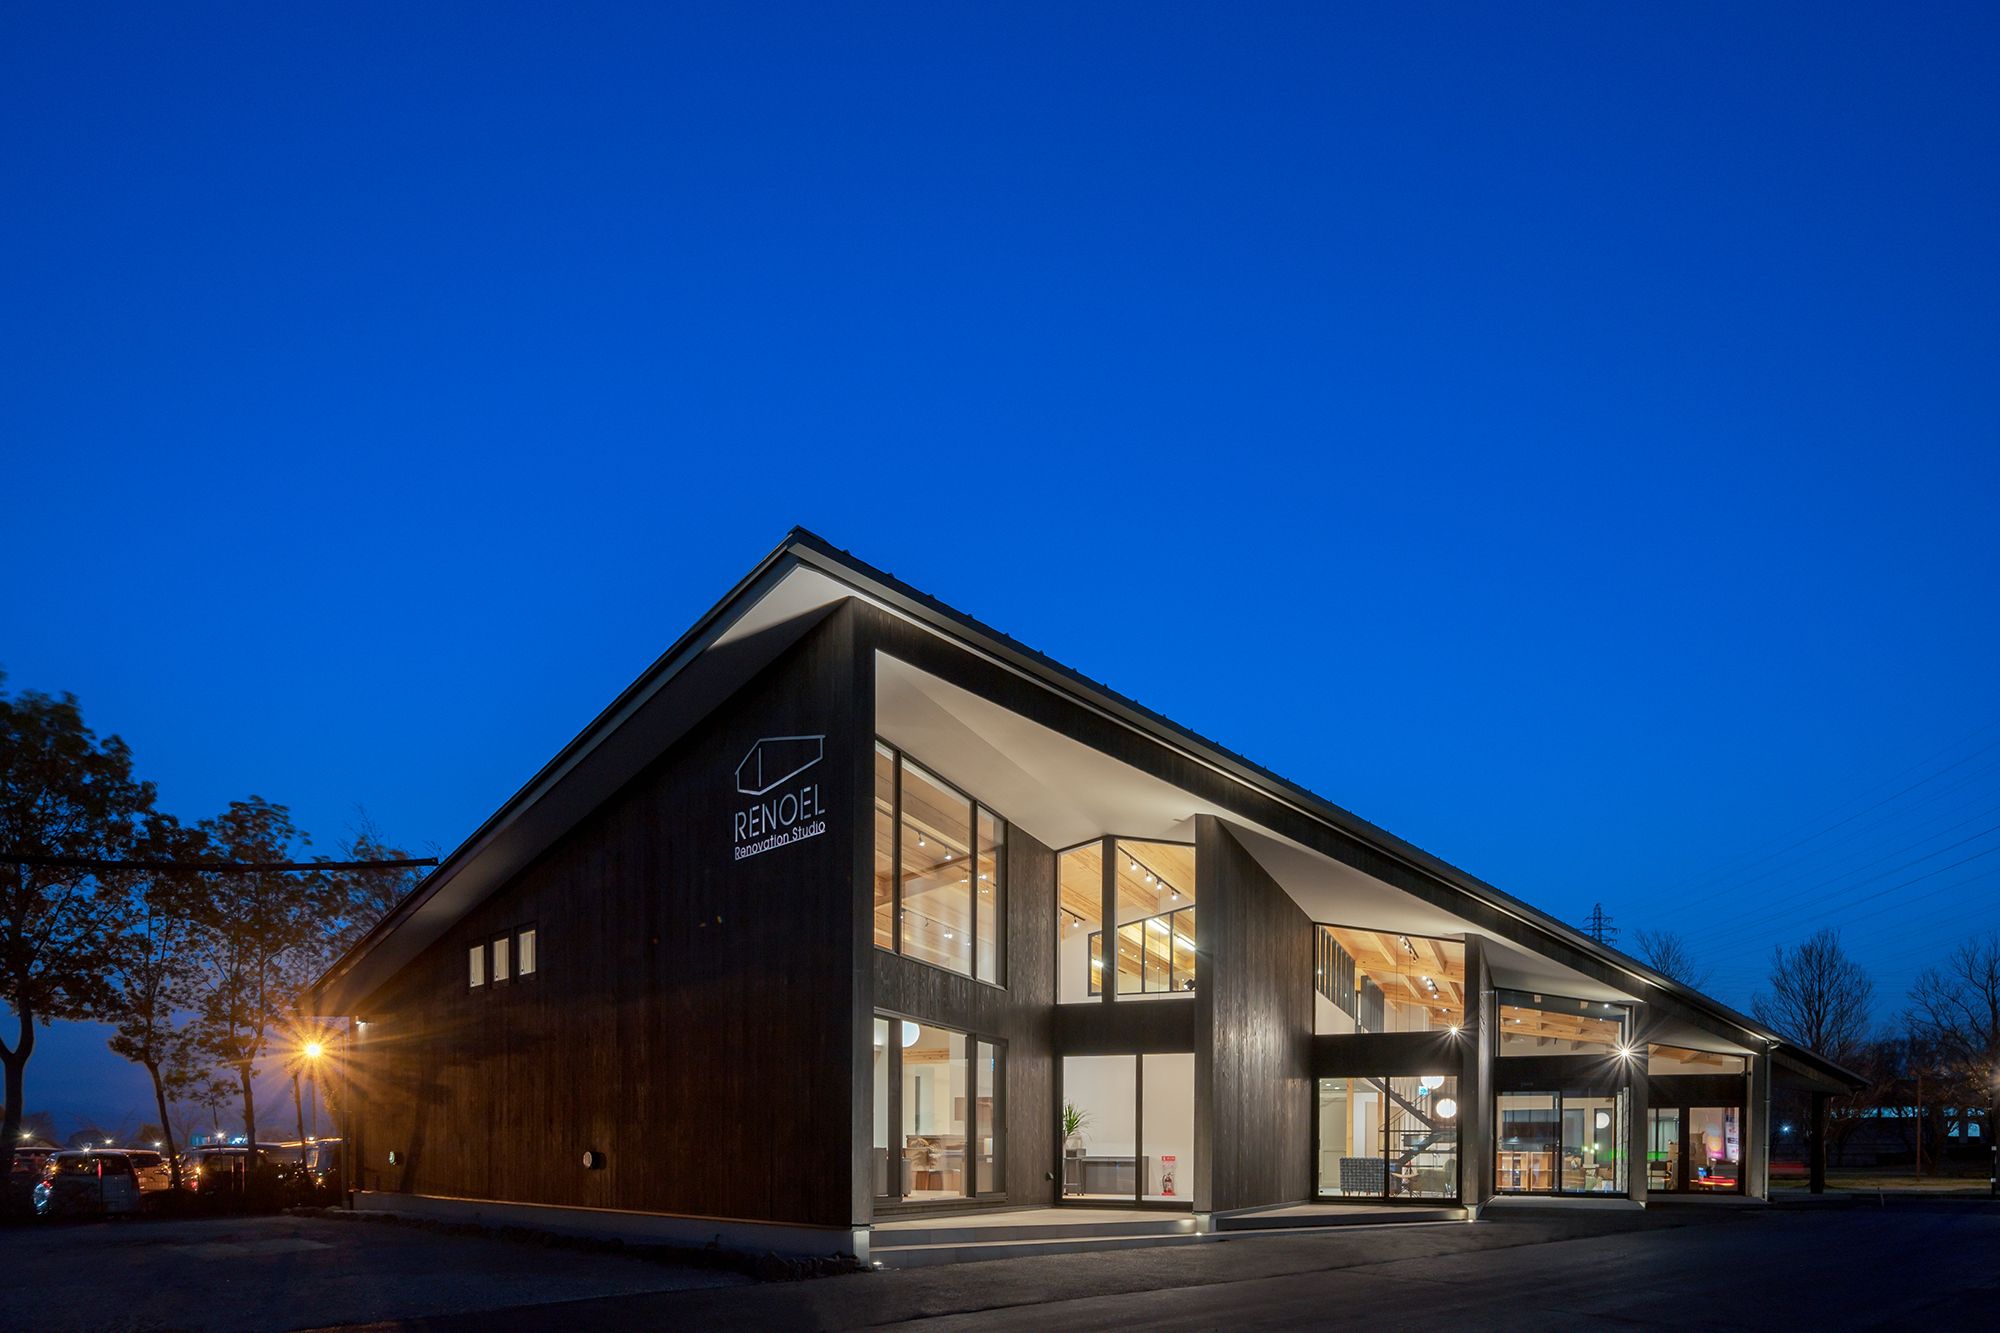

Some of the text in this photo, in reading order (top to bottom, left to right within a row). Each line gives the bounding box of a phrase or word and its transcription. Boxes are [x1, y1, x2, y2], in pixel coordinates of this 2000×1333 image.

[735, 784, 825, 842] RENOEL
[735, 821, 825, 859] Renovation Studio
